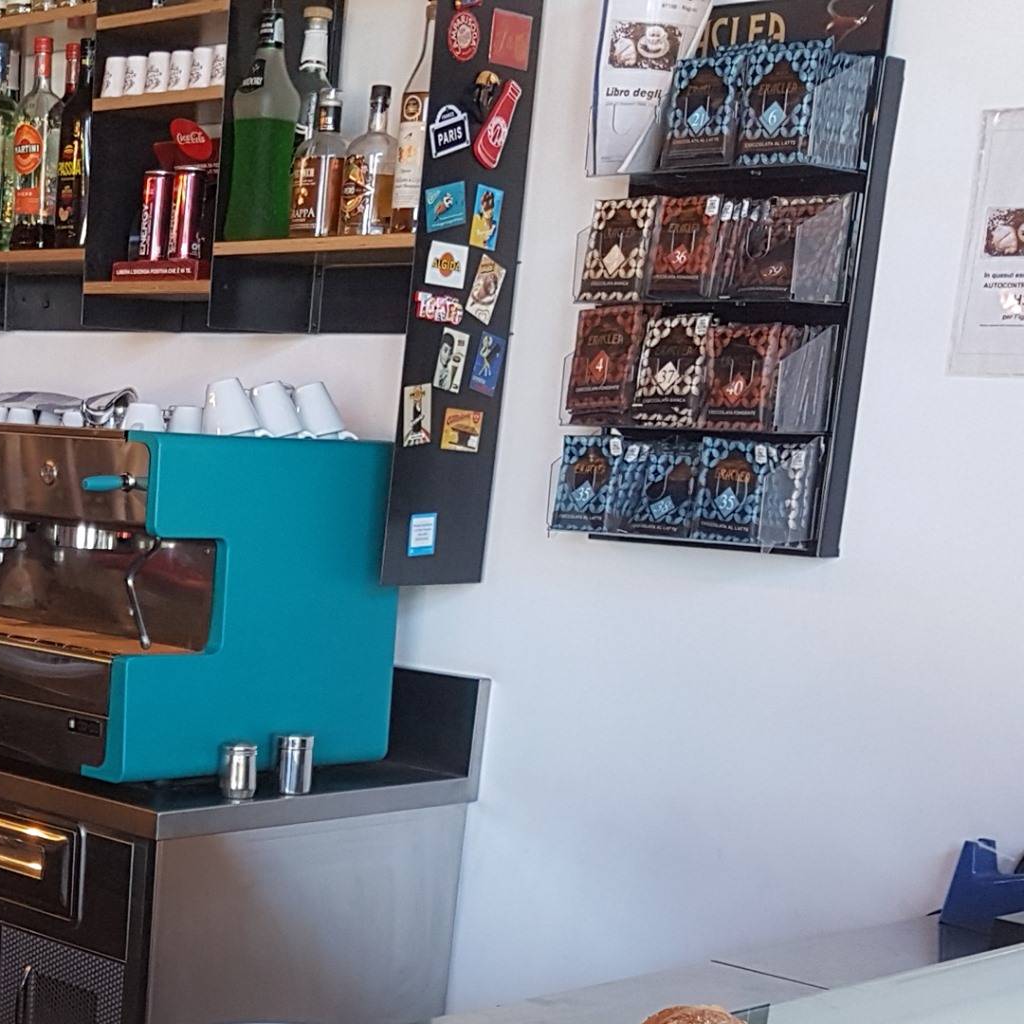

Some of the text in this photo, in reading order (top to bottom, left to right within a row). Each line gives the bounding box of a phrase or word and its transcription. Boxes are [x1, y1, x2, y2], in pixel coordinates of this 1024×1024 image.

[695, 11, 786, 58] ACLEA
[605, 87, 663, 101] Libro degli
[768, 110, 777, 126] 6
[437, 125, 464, 147] PARIS
[14, 144, 40, 154] MARTINI
[139, 203, 150, 257] ENERGY
[431, 256, 462, 273] ALGIDA
[671, 250, 687, 264] 36
[595, 357, 604, 373] 4
[659, 369, 675, 384] 37
[577, 486, 591, 500] 35
[719, 494, 736, 511] 35
